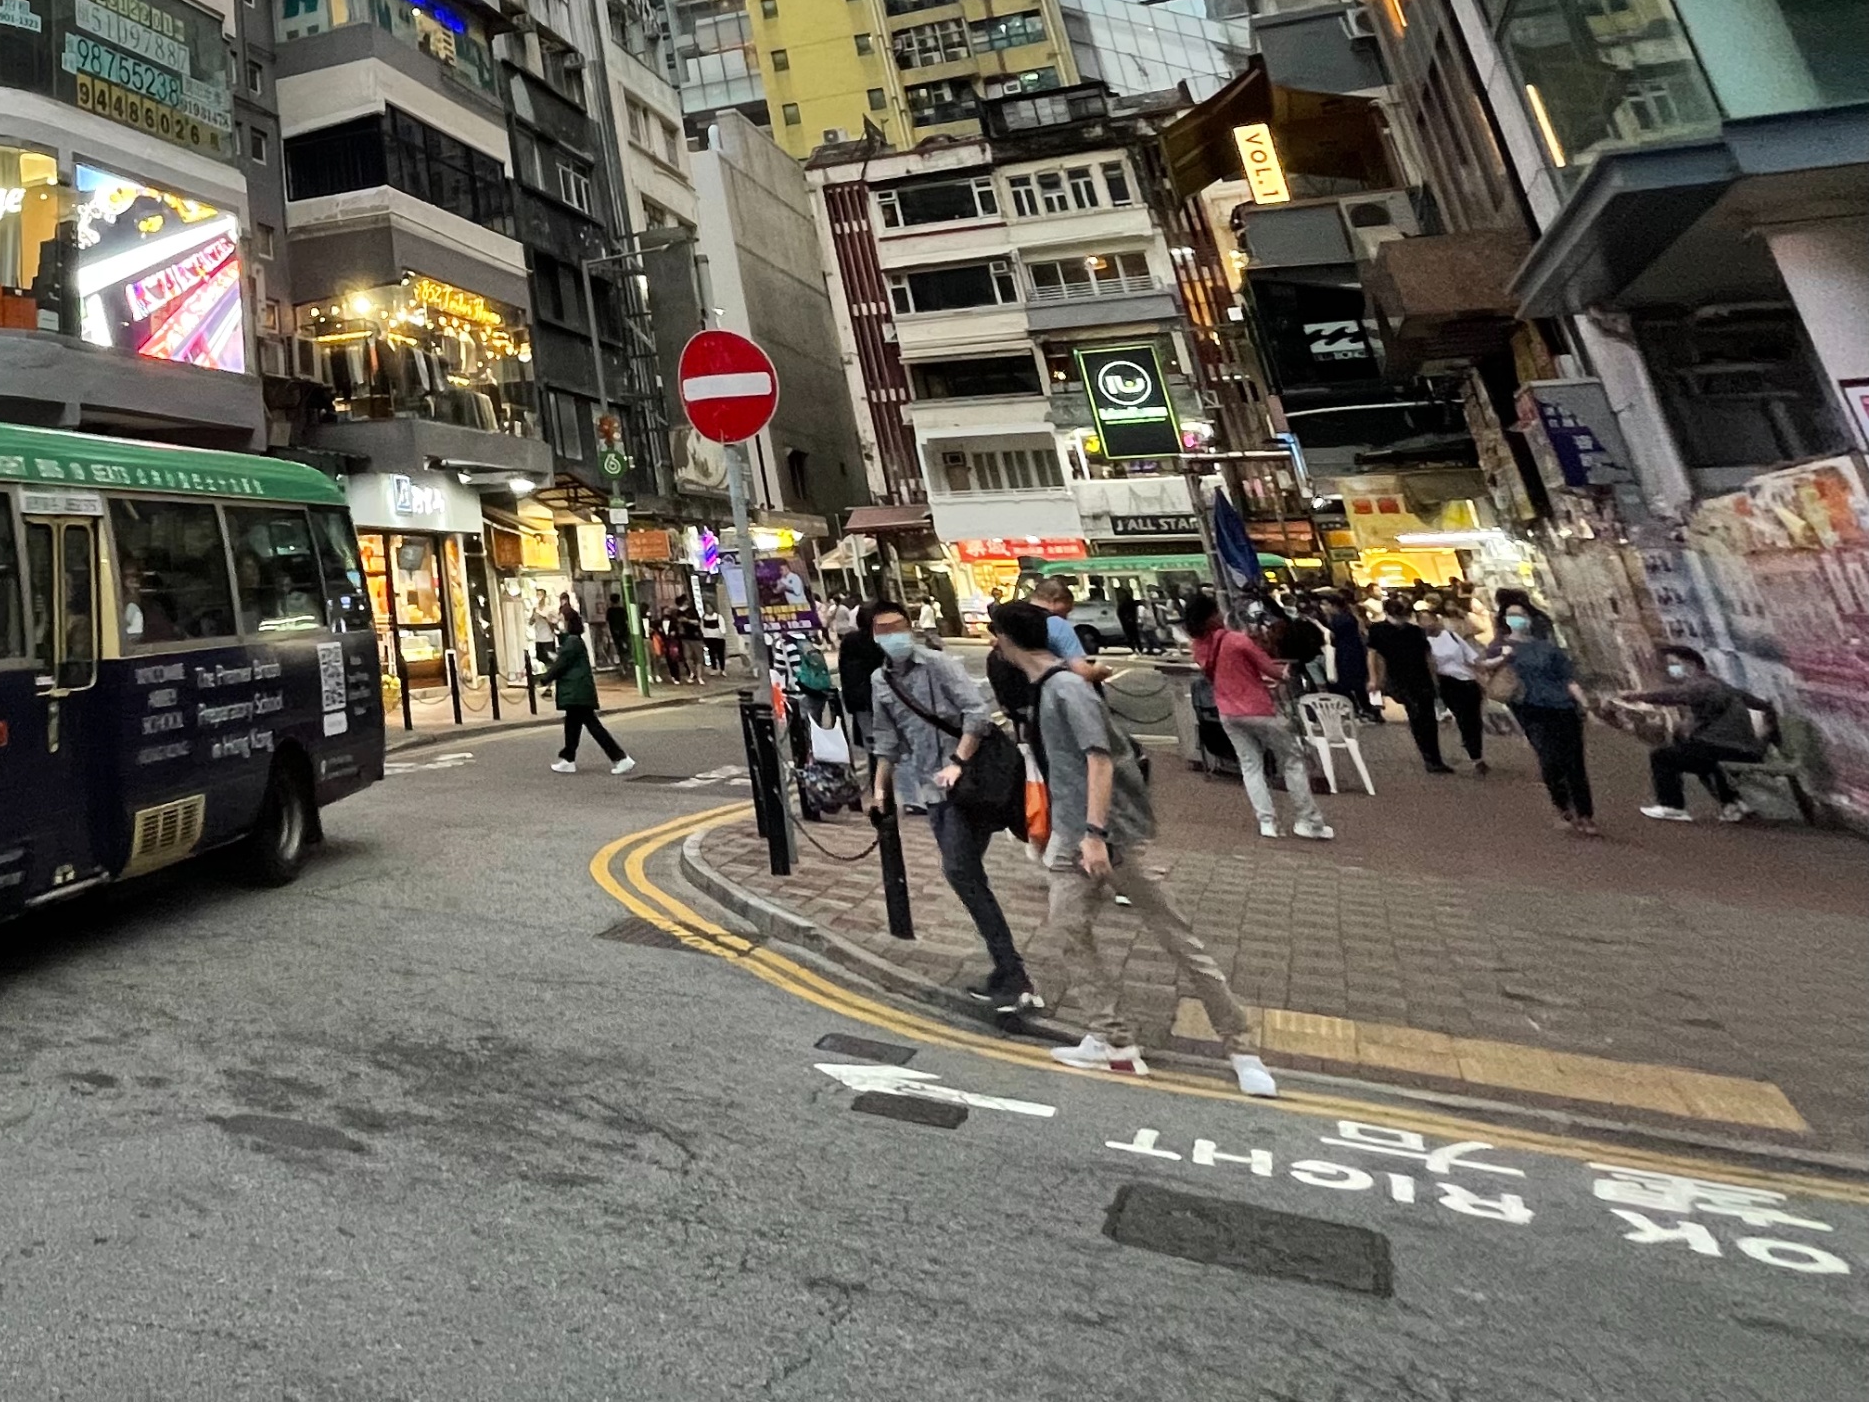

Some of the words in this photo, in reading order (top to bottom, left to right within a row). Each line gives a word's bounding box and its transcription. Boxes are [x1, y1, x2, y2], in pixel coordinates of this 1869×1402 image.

[77, 38, 180, 108] 98755238
[79, 83, 200, 146] 94486026
[1244, 132, 1281, 199] VOL.1
[1104, 1127, 1537, 1227] RIGHT
